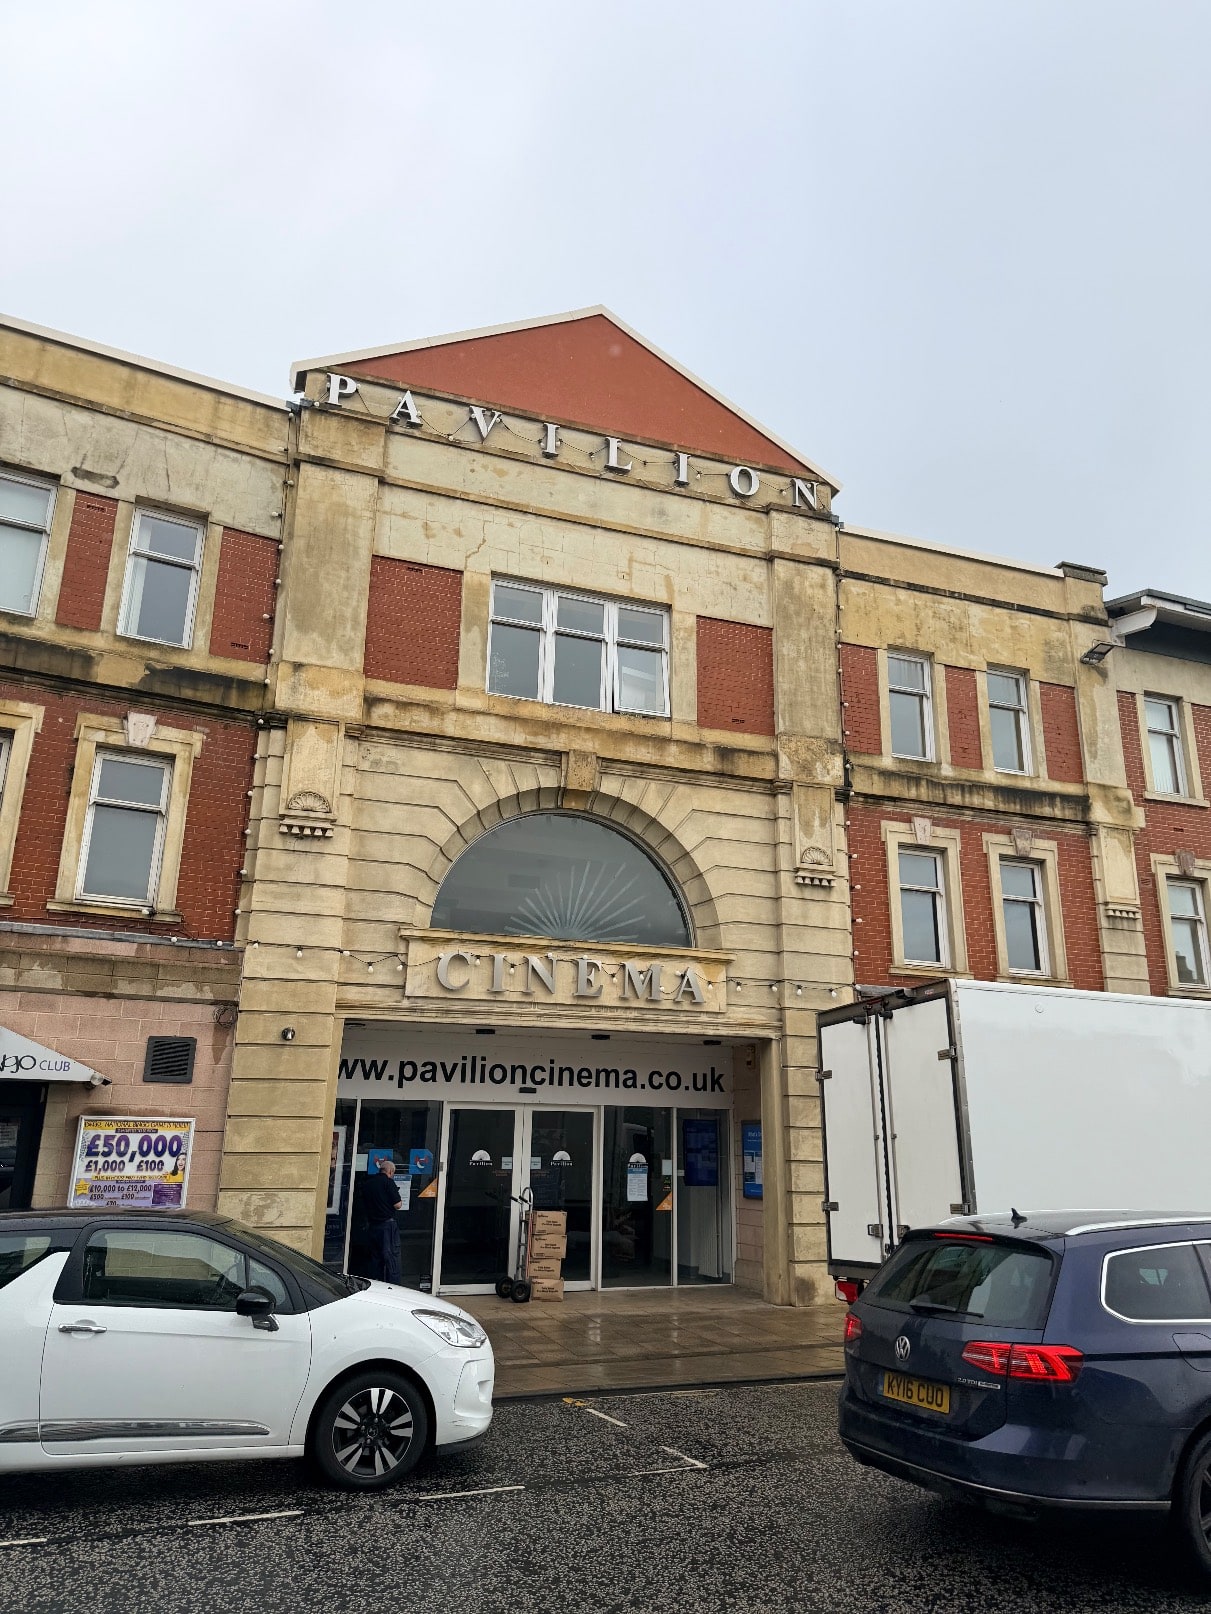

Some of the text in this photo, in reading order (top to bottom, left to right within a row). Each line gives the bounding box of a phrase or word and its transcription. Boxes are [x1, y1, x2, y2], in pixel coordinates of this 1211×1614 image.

[326, 372, 819, 510] PAVILION
[436, 952, 705, 1003] CINEMA
[39, 1060, 71, 1072] CLUB
[85, 1134, 183, 1163] £50,000
[85, 1160, 164, 1175] £1,000 £100
[89, 1184, 116, 1194] £10,000
[126, 1184, 152, 1194] £12,000
[887, 1374, 944, 1408] KY16 CUO
